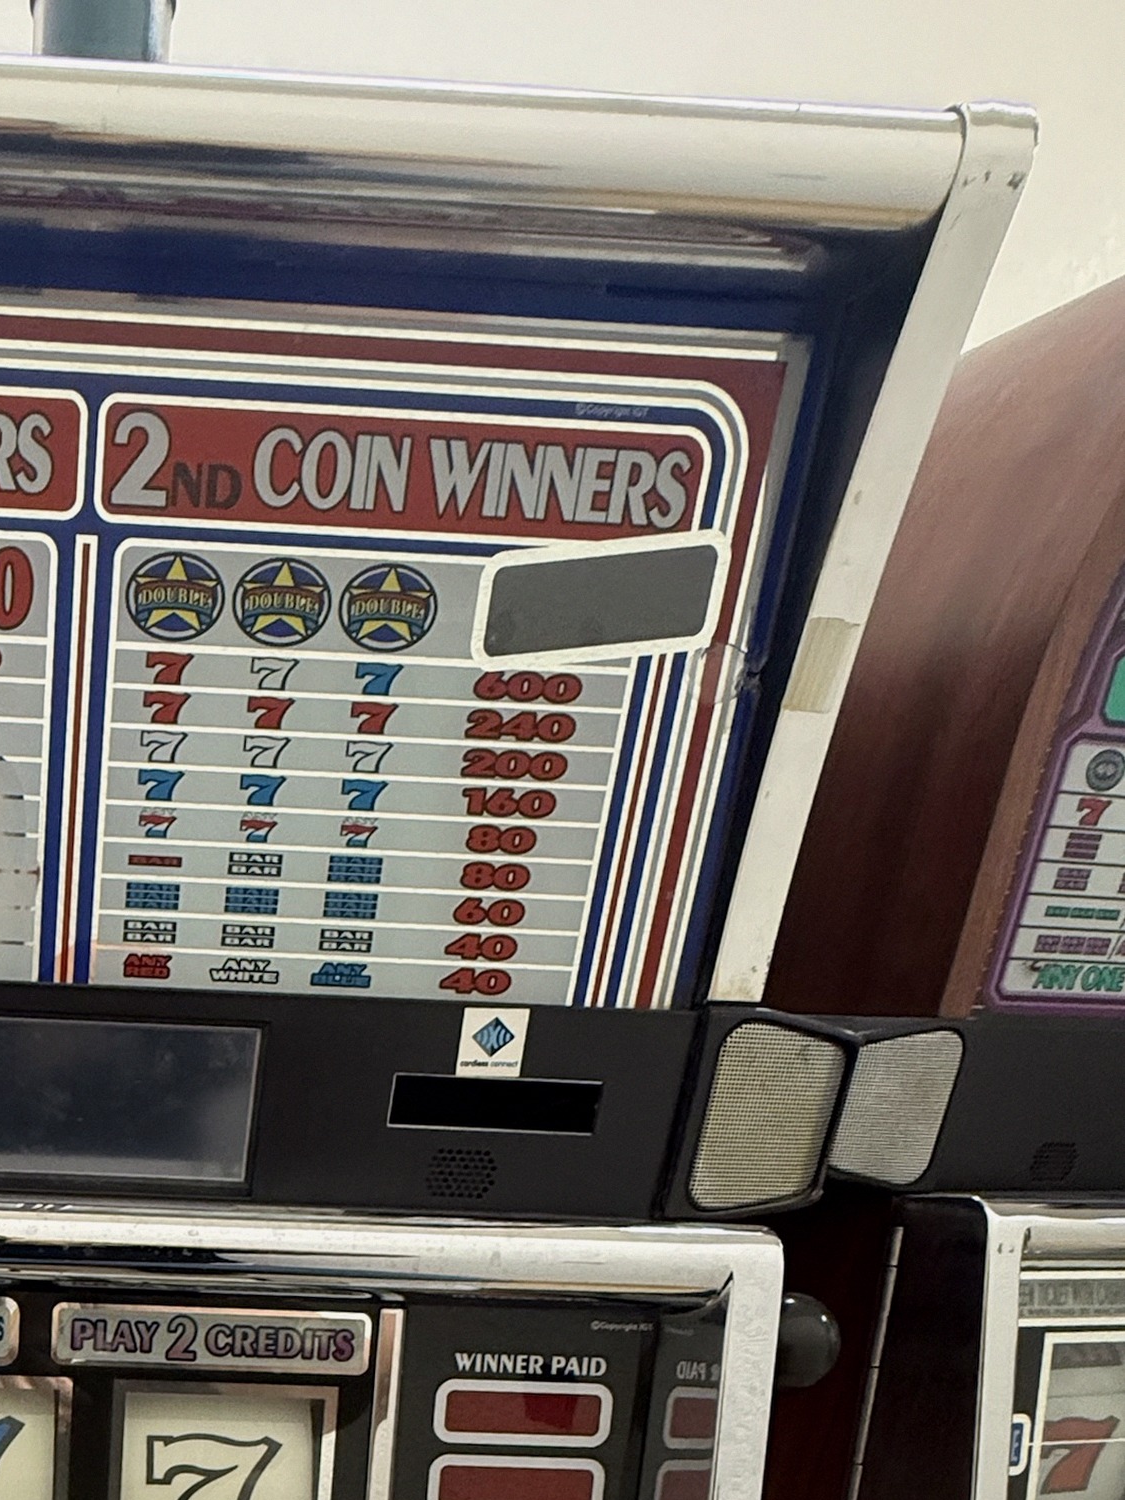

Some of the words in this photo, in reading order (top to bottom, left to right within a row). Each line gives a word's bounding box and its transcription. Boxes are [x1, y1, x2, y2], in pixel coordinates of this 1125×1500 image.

[253, 427, 410, 513] COIN
[429, 436, 694, 530] WINNERS
[138, 587, 214, 607] DOUBLE
[245, 592, 321, 613] DOUBLE
[351, 599, 427, 618] DOUBLE
[473, 671, 582, 704] 600
[464, 708, 576, 742] 240
[460, 748, 568, 781] 200
[462, 787, 557, 819] 160
[465, 824, 538, 855] 80
[460, 861, 532, 892] 80
[452, 897, 525, 927] 60
[444, 933, 518, 962] 40
[439, 968, 511, 996] 40
[70, 1319, 159, 1353] PLAY
[166, 1314, 198, 1362] 2
[204, 1323, 355, 1362] CREDITS
[455, 1352, 543, 1375] WINNER
[551, 1356, 607, 1377] PAID
